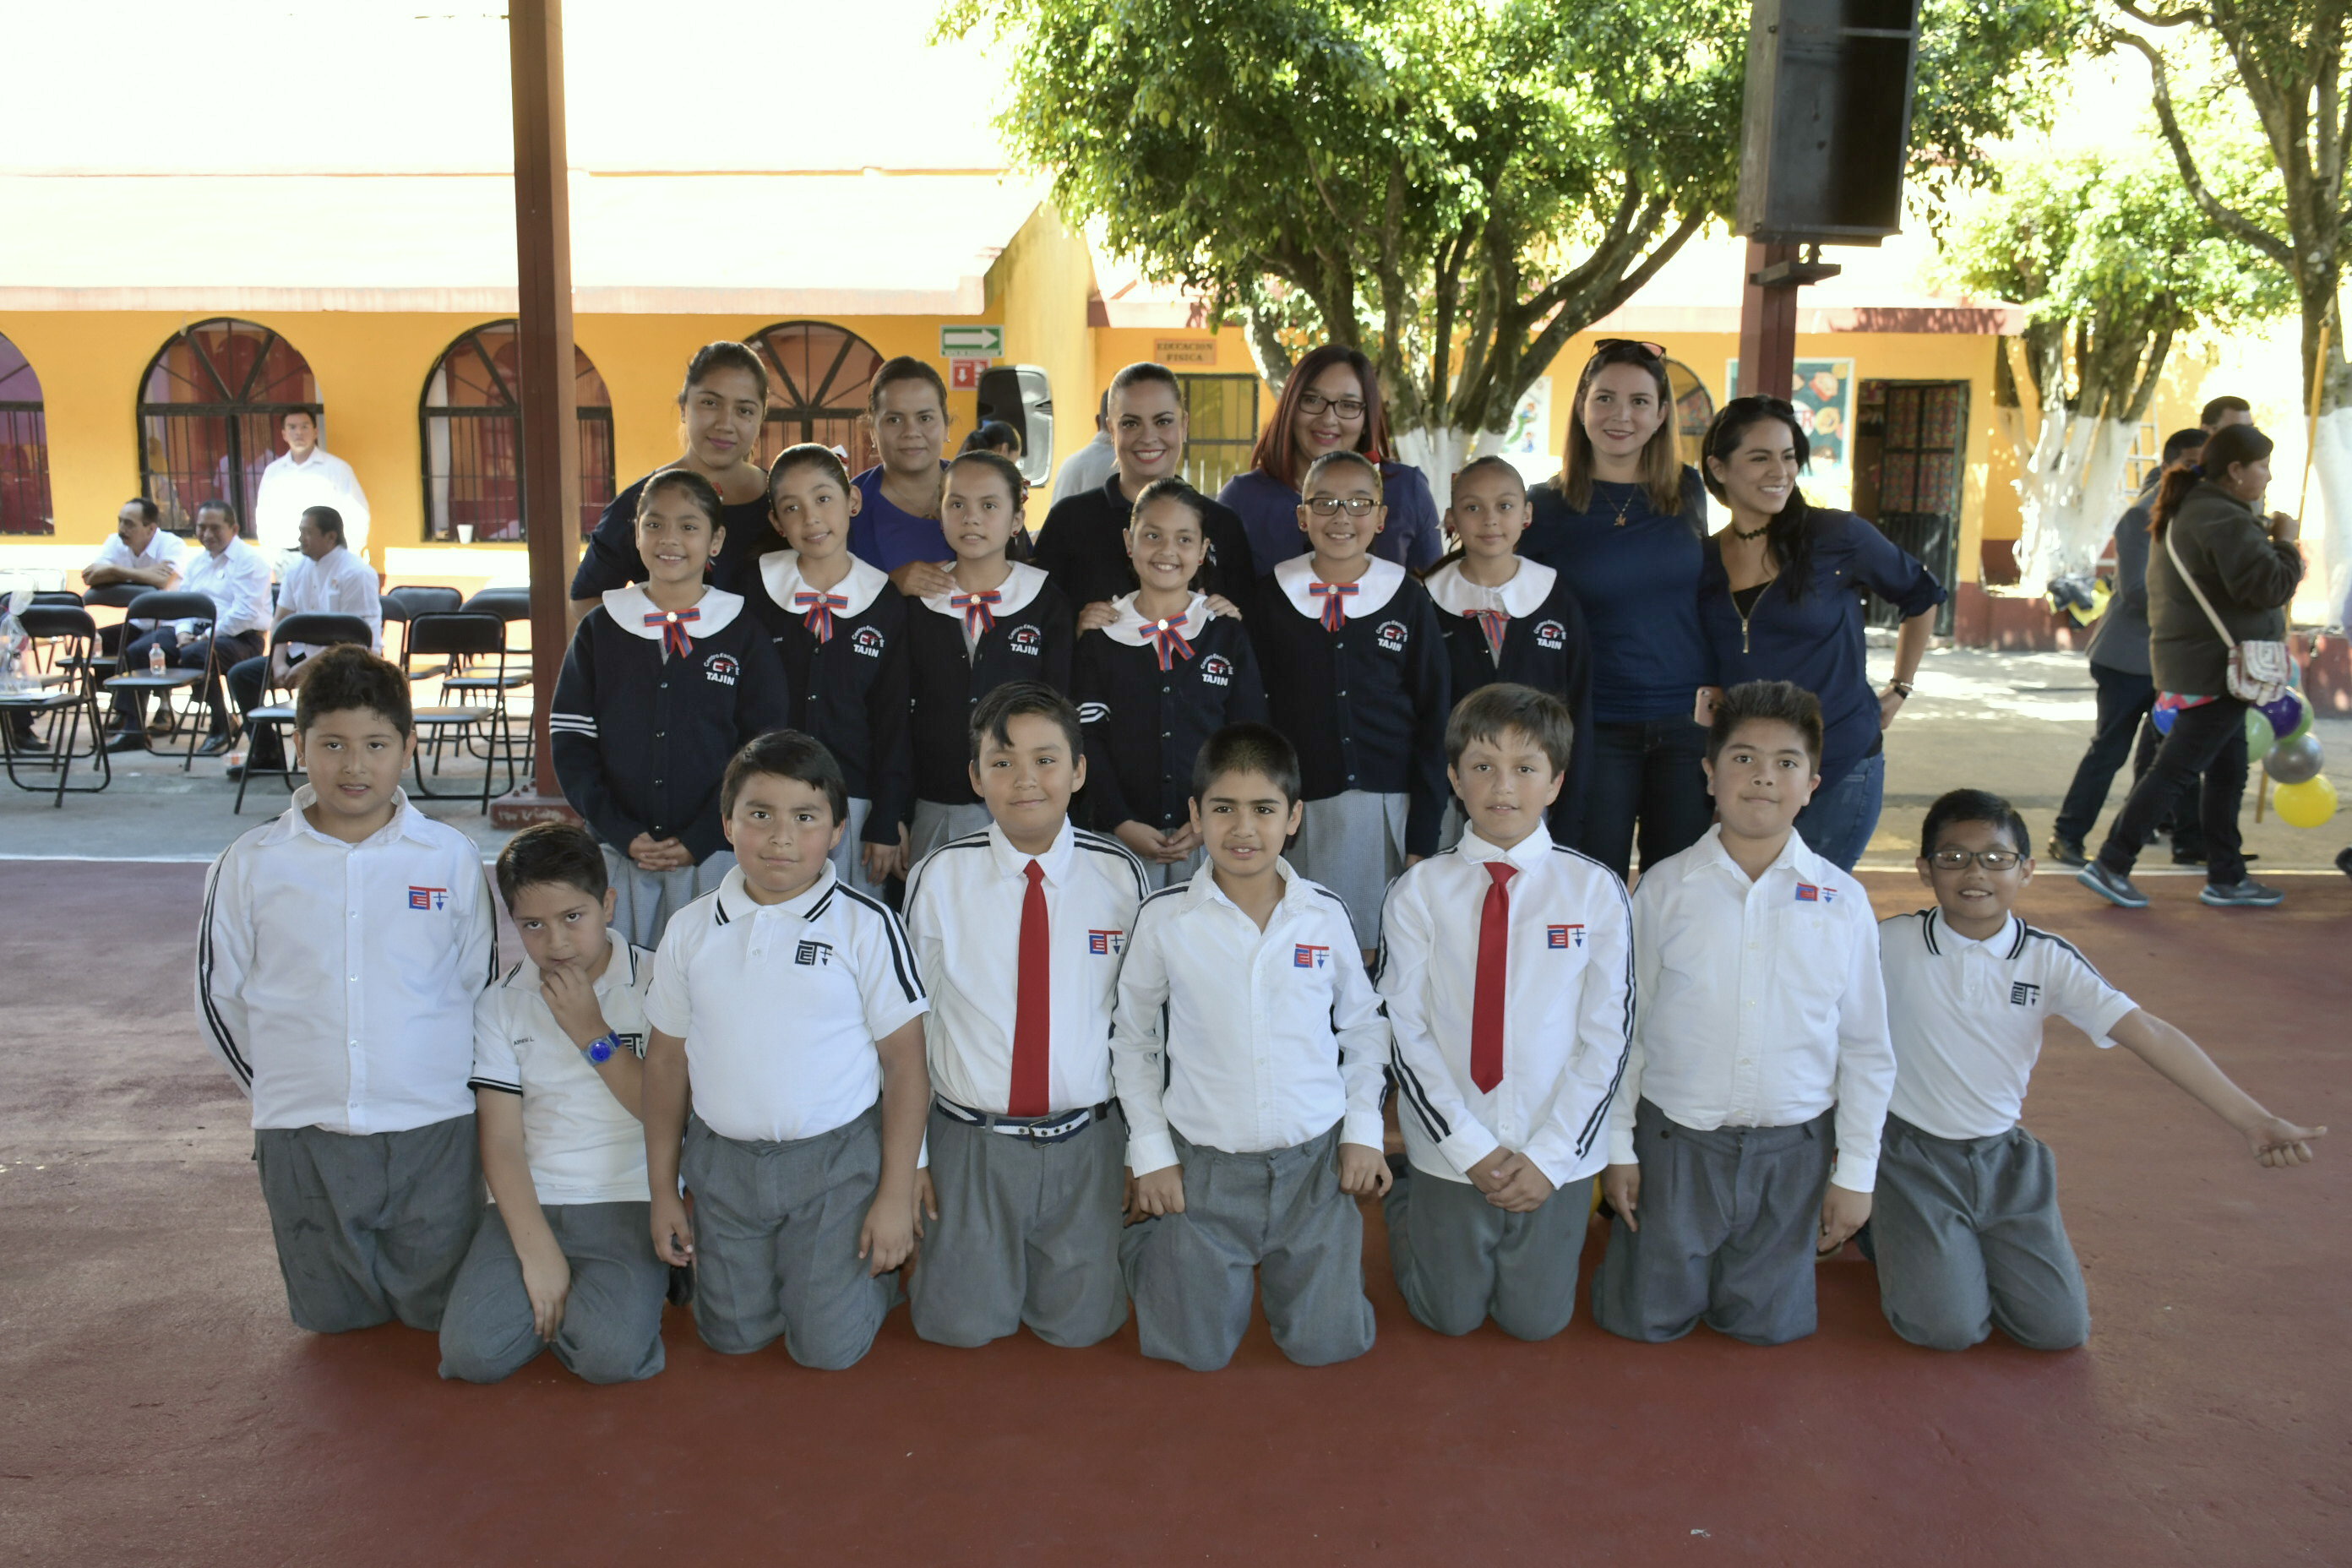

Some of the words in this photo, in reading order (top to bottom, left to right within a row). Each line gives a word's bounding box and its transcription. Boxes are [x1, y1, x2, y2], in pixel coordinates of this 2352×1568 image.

[853, 644, 879, 657] TAJIN
[1010, 643, 1039, 656] TAJIN
[1378, 638, 1402, 651] TAJIN
[1536, 638, 1562, 651] TAJIN
[705, 672, 735, 686] TAJIN
[1202, 673, 1229, 686] TAJIN
